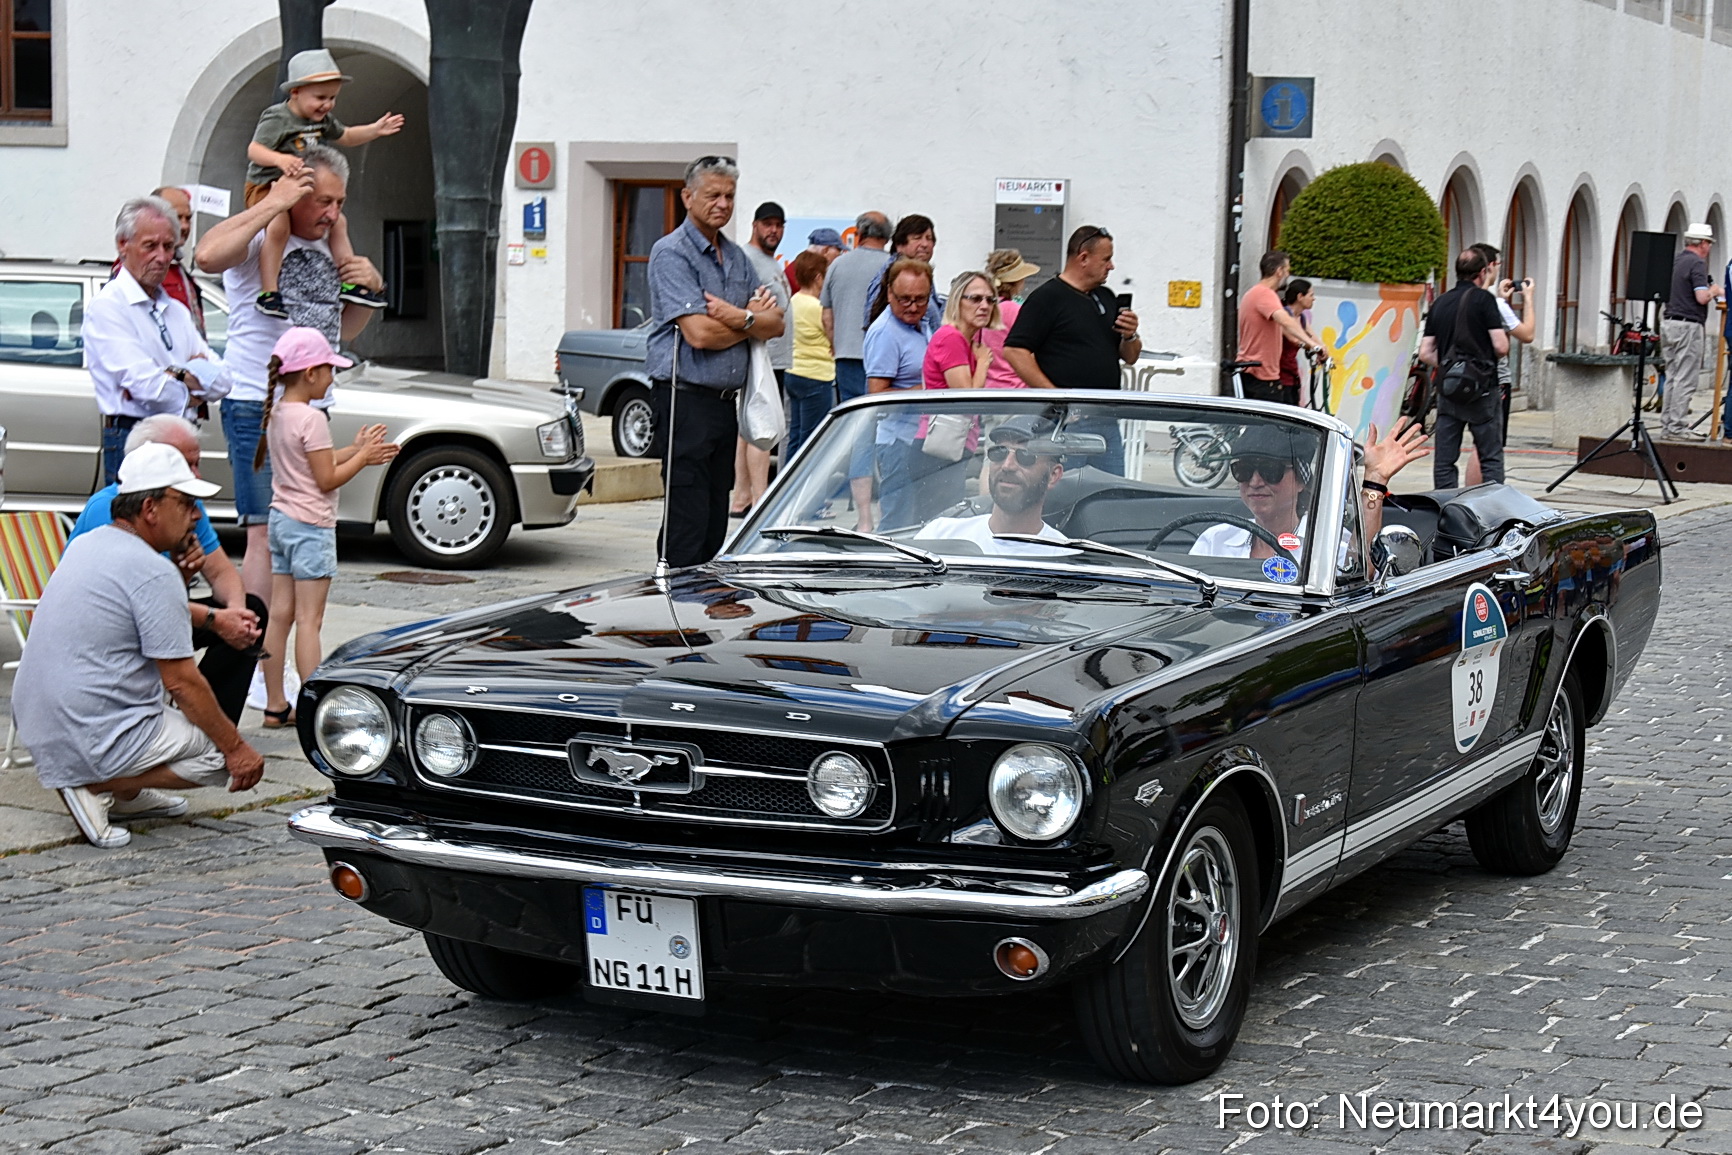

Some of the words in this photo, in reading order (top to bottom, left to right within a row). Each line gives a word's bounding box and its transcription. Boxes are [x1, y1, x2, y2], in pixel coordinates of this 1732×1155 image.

[998, 181, 1053, 192] NEUMARKT
[1468, 669, 1483, 706] 38
[465, 685, 812, 723] FORD
[591, 916, 602, 929] D
[616, 894, 654, 925] FÜ
